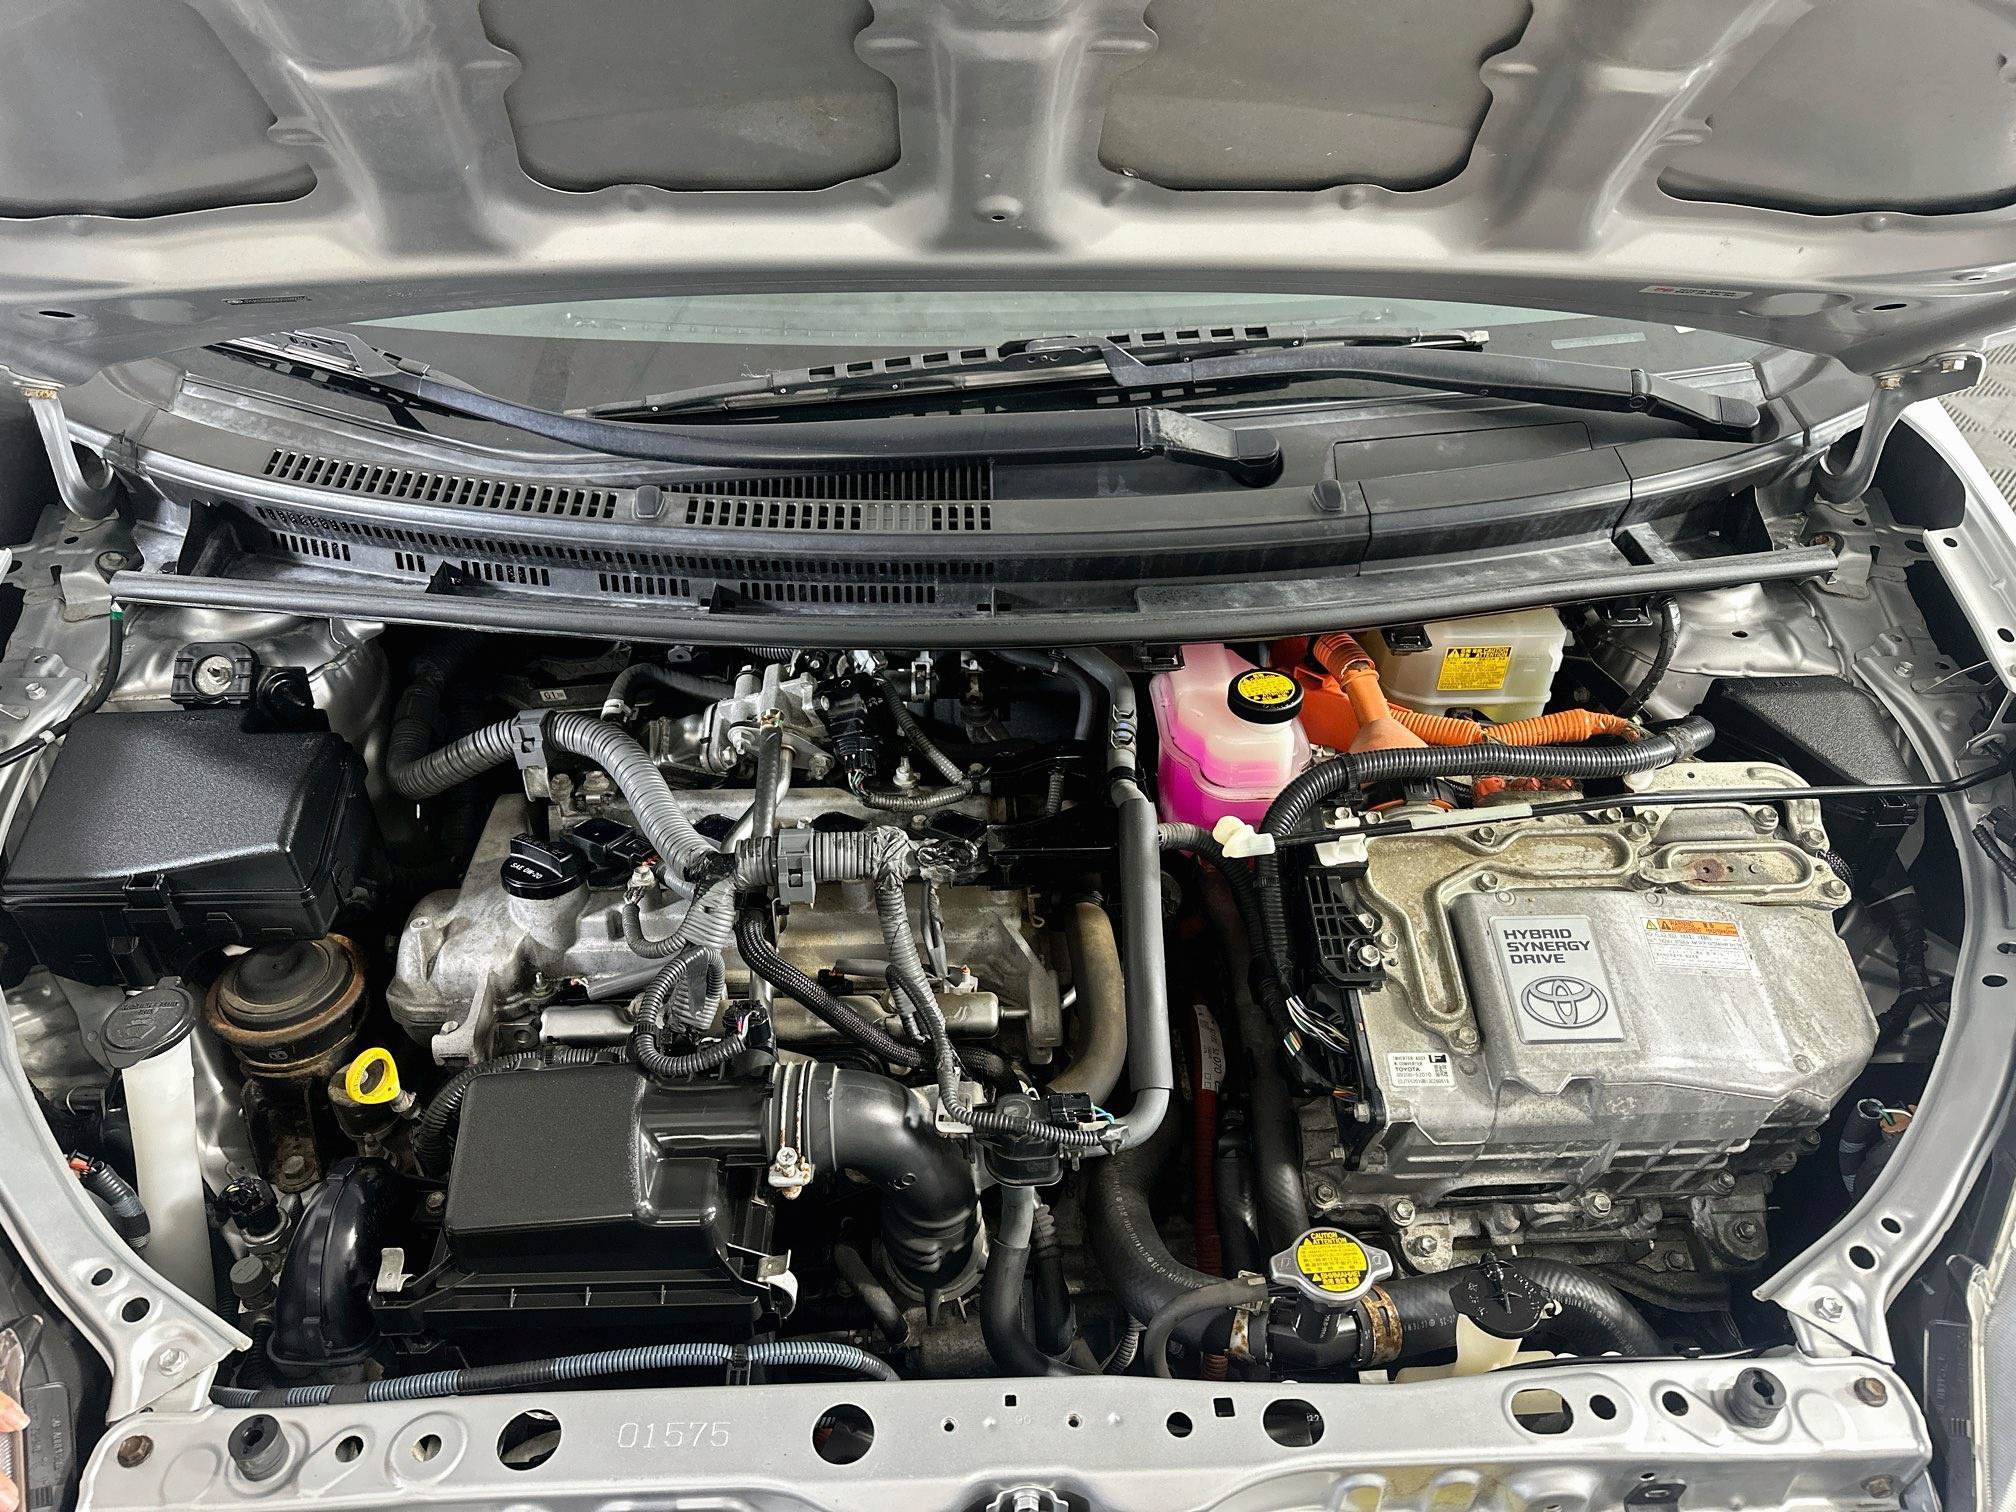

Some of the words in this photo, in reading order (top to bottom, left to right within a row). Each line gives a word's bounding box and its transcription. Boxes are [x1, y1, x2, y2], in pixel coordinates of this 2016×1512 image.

[510, 862, 525, 871] SAE
[523, 867, 543, 879] 0W-20
[1503, 928, 1572, 940] HYBRID
[1506, 940, 1590, 952] SYNERGY
[1510, 953, 1566, 964] DRIVE
[1312, 1237, 1348, 1245] ATTENTION
[617, 1422, 731, 1448] 01575
